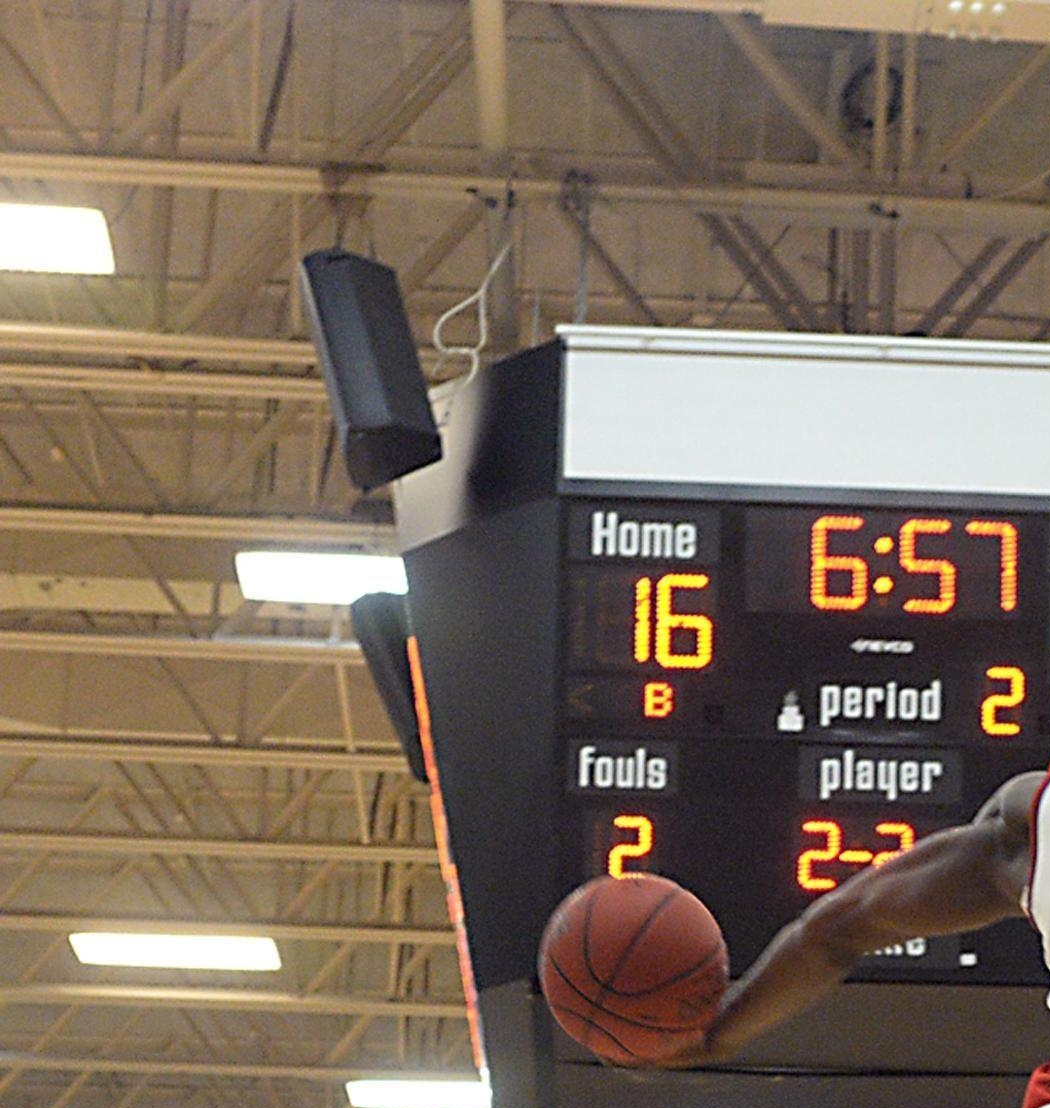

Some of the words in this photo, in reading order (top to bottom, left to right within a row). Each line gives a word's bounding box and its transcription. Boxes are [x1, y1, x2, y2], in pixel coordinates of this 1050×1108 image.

[591, 511, 697, 559] Home
[810, 515, 1018, 614] 6:57
[634, 573, 713, 669] 16
[643, 682, 674, 718] B
[820, 679, 941, 727] period
[980, 666, 1026, 735] 2
[578, 747, 668, 790] fouls
[820, 750, 944, 801] player
[607, 814, 654, 880] 2
